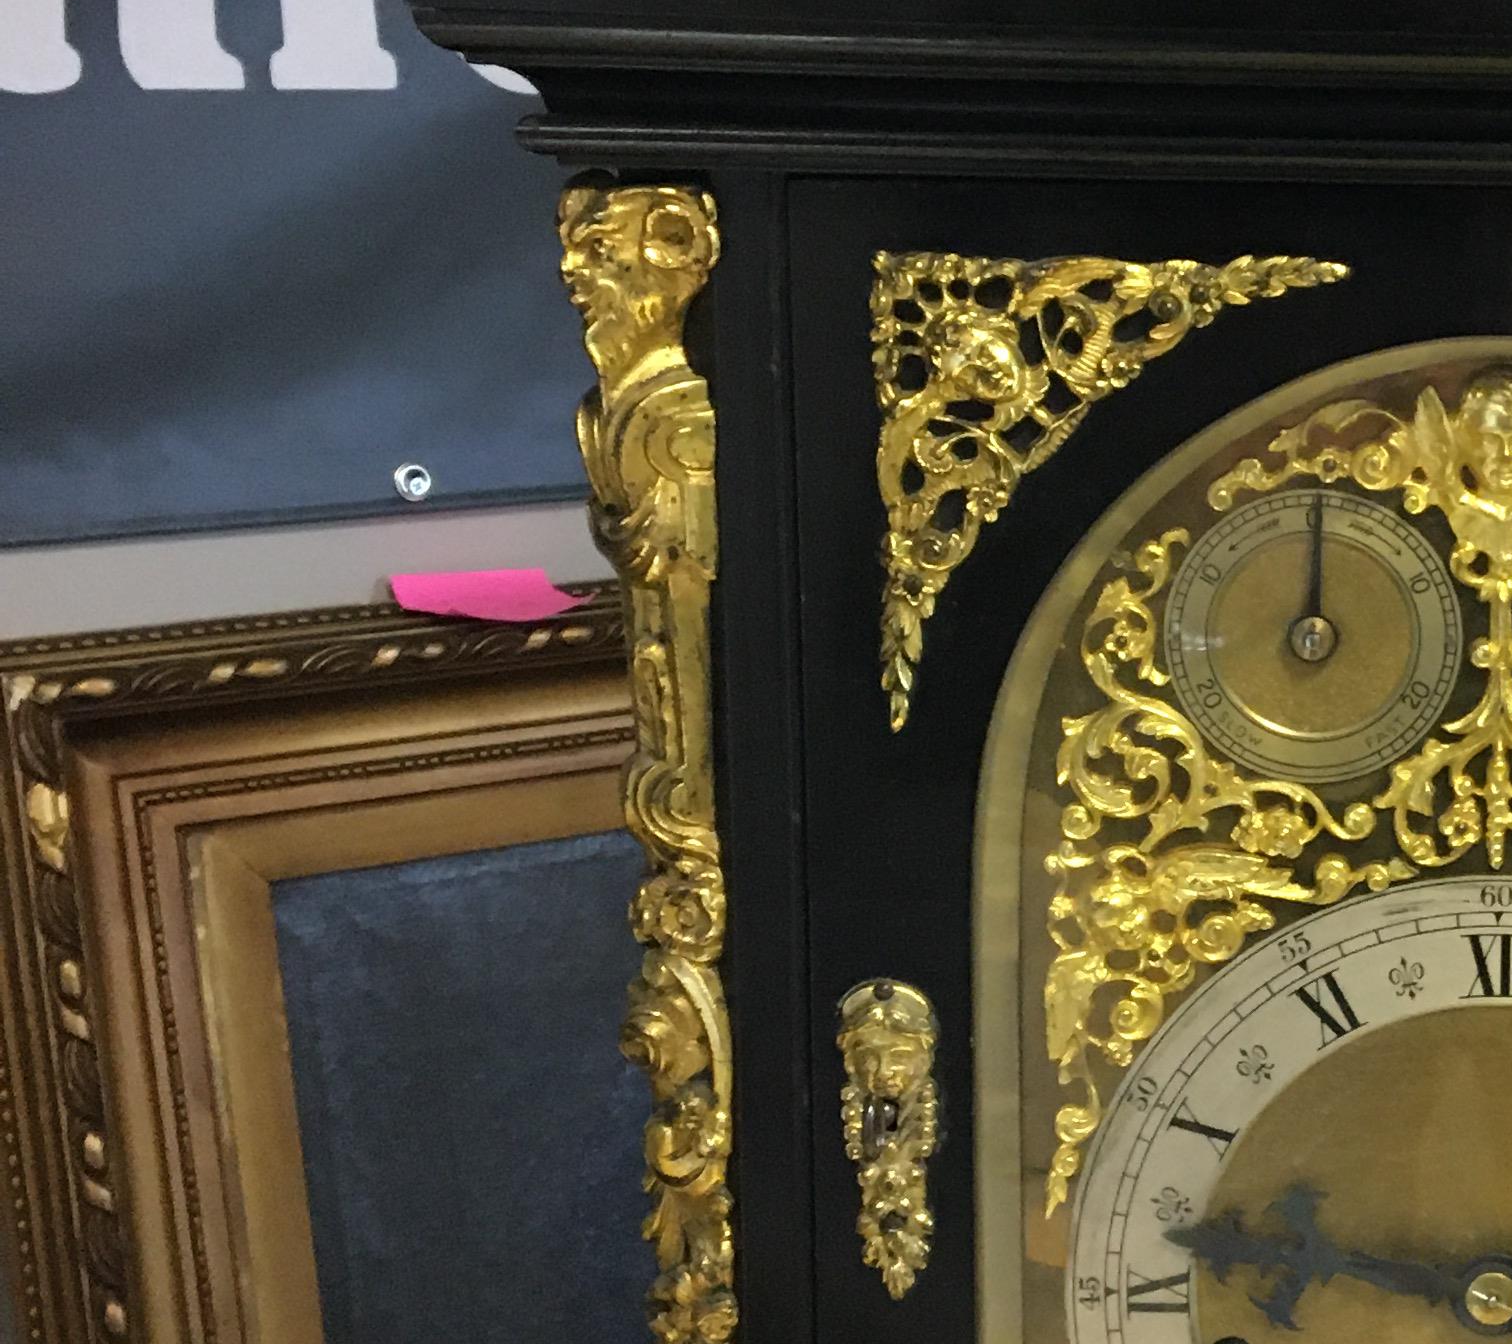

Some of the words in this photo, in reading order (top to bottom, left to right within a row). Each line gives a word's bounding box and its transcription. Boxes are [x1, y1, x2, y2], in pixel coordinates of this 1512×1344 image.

[1199, 562, 1222, 586] 10
[1410, 570, 1433, 595] 10
[1196, 678, 1222, 710] 20
[1402, 680, 1430, 710] 20
[1278, 931, 1312, 963] 55
[1288, 967, 1369, 1051] XI
[1127, 1076, 1159, 1113] 50
[1167, 1097, 1239, 1160] X
[1079, 1277, 1101, 1310] 45
[1126, 1265, 1192, 1319] IX
